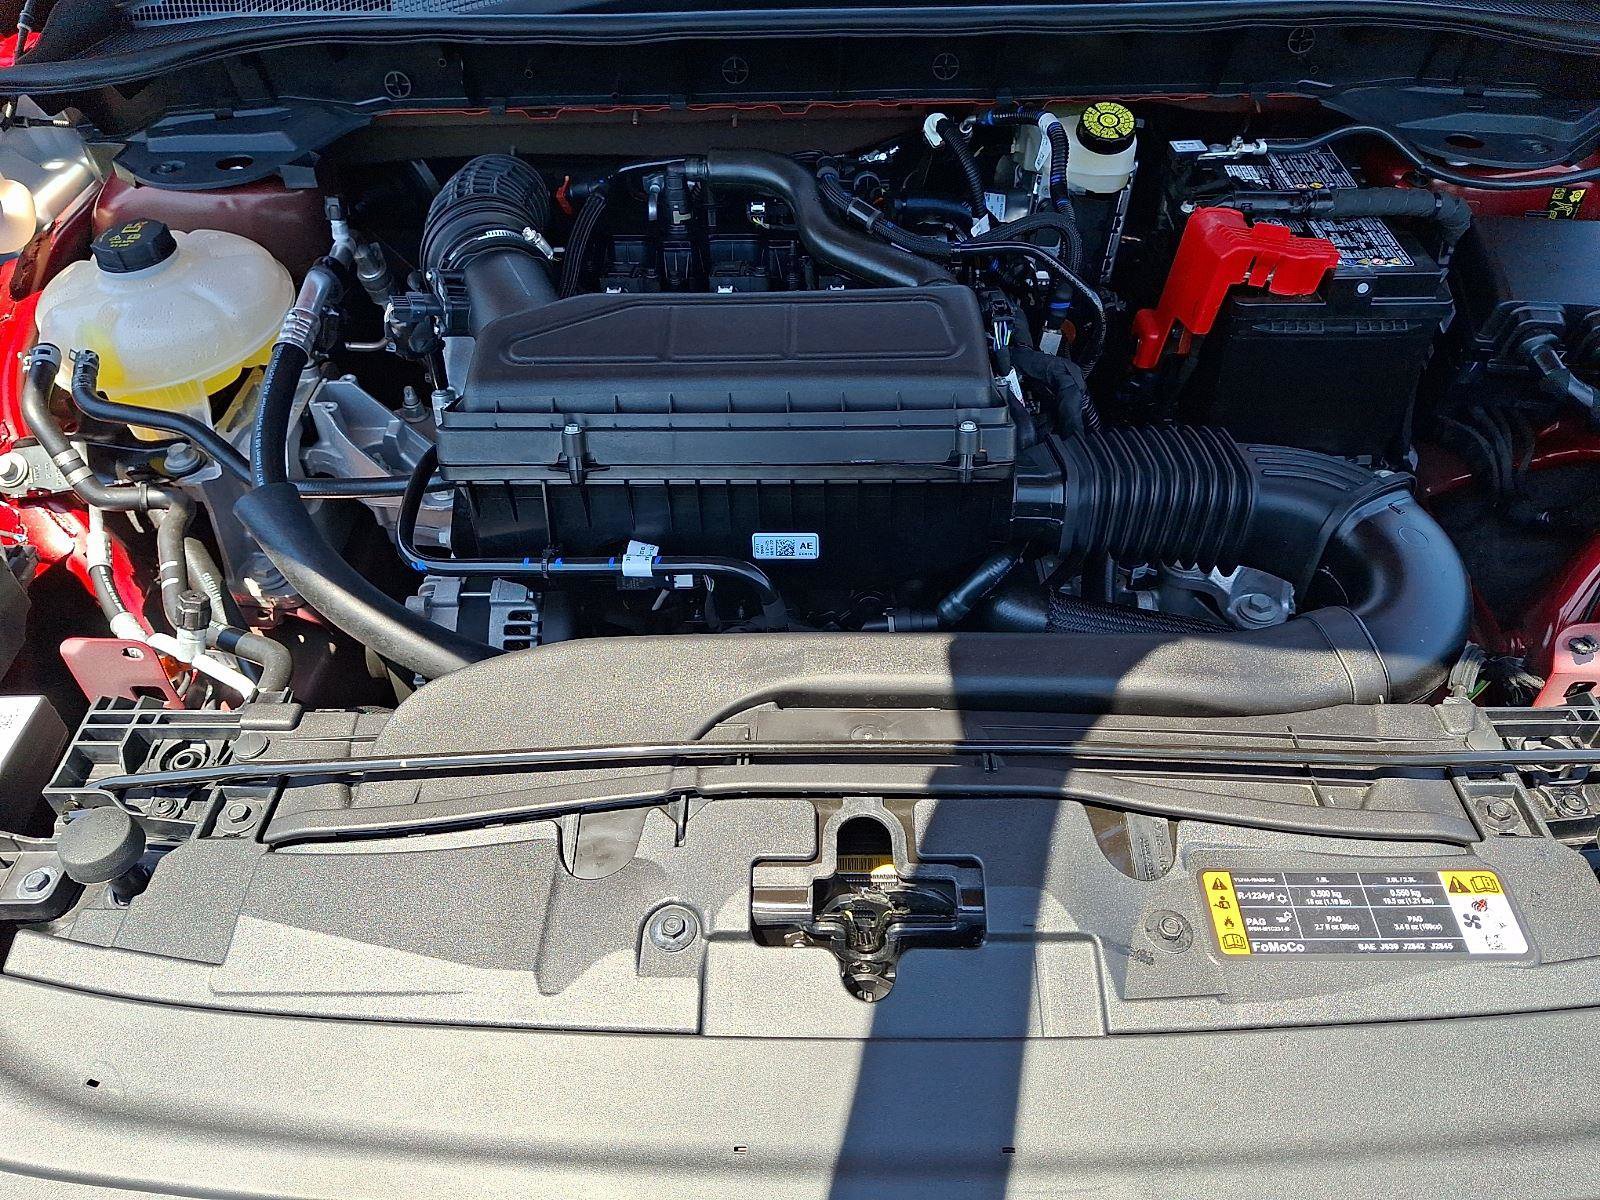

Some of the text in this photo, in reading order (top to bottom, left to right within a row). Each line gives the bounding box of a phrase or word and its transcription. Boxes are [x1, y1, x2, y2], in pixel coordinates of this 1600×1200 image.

[1237, 892, 1275, 901] R-1234yf
[1332, 890, 1342, 899] kg
[1412, 889, 1422, 898] kg
[1252, 942, 1305, 953] FoMoCo
